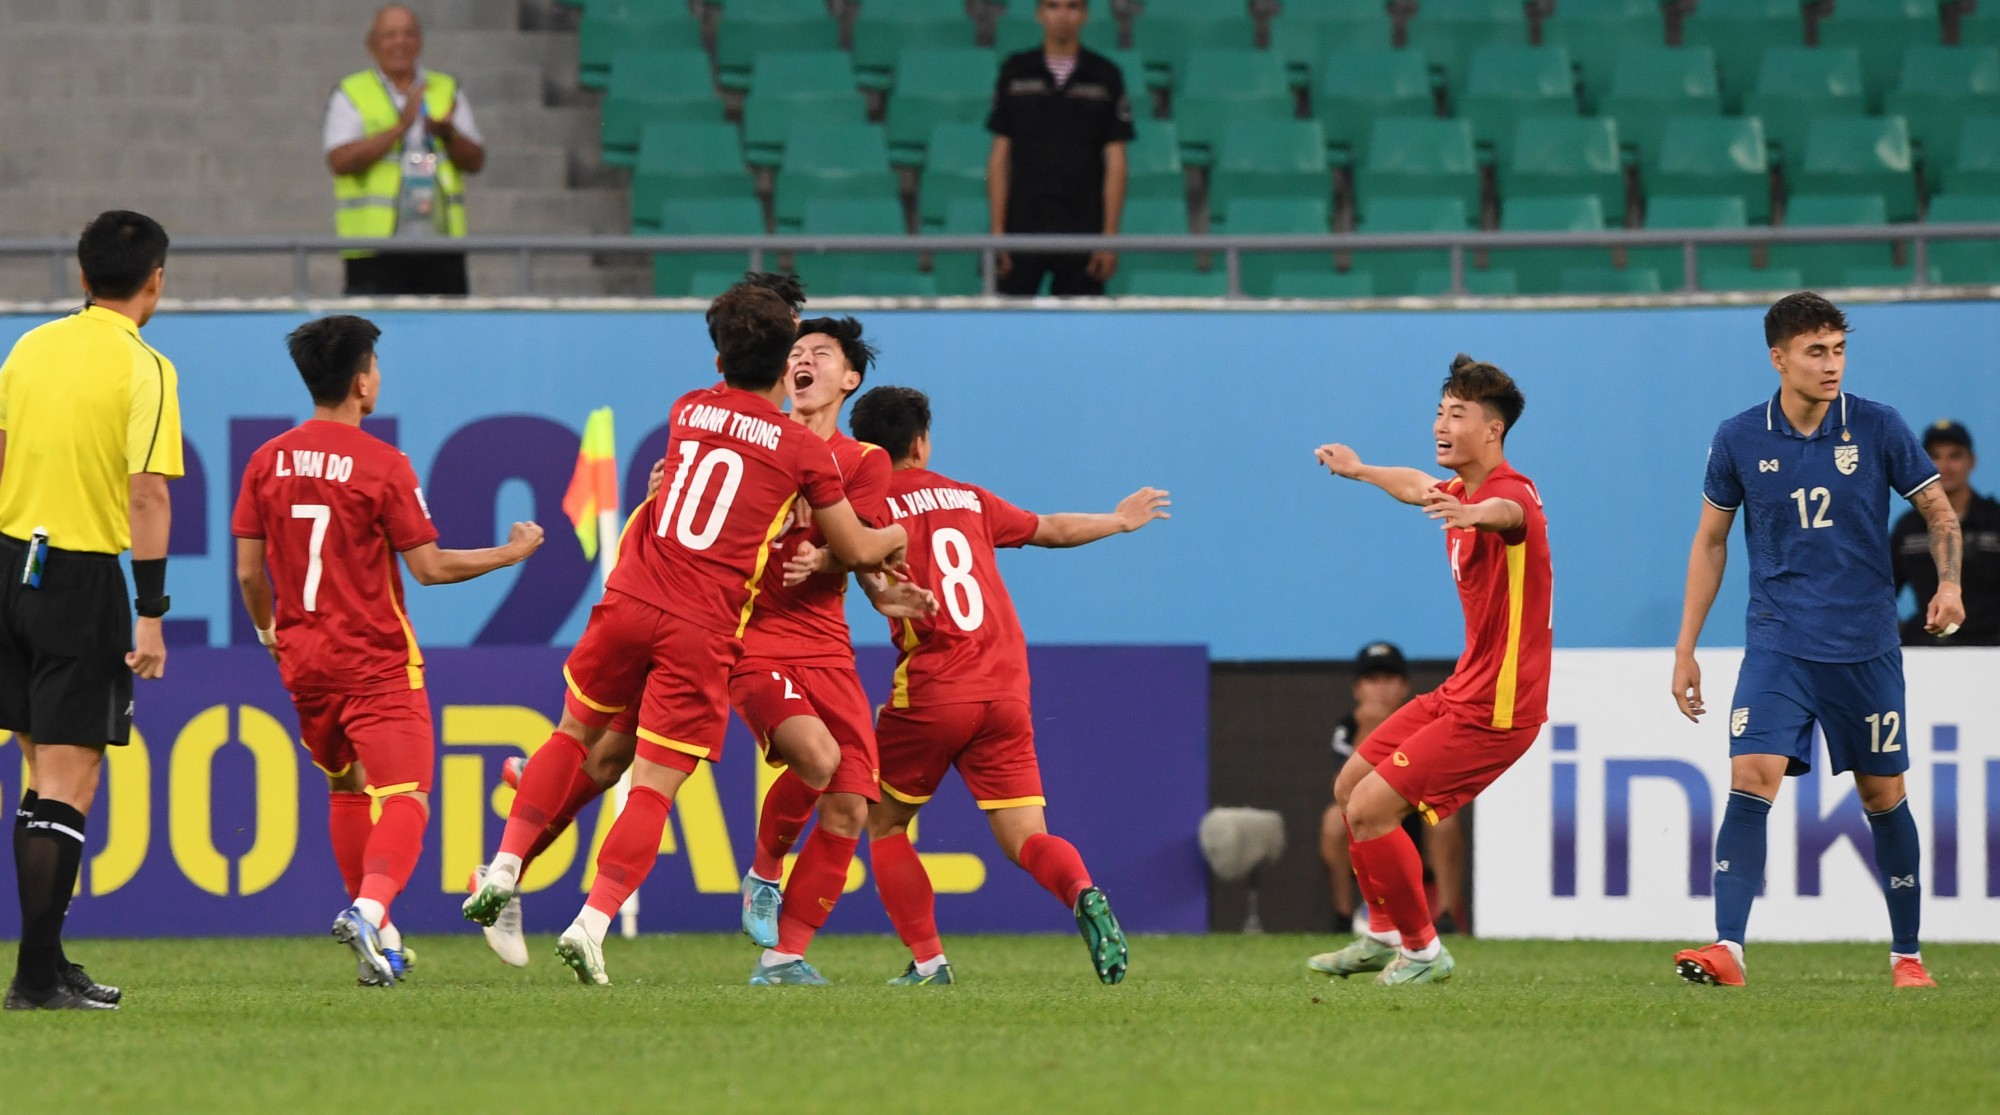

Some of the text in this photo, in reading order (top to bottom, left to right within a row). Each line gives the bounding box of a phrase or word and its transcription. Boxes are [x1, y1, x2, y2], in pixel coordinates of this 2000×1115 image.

[688, 403, 731, 434] DANH
[729, 411, 782, 452] TRUNG
[292, 449, 326, 479] VAN
[324, 453, 354, 483] DO
[657, 440, 744, 551] 10
[901, 487, 940, 516] VAN
[933, 487, 983, 514] KHANG
[1790, 486, 1834, 529] 12
[291, 504, 332, 612] 7
[931, 527, 985, 632] 8
[1864, 710, 1902, 753] 12
